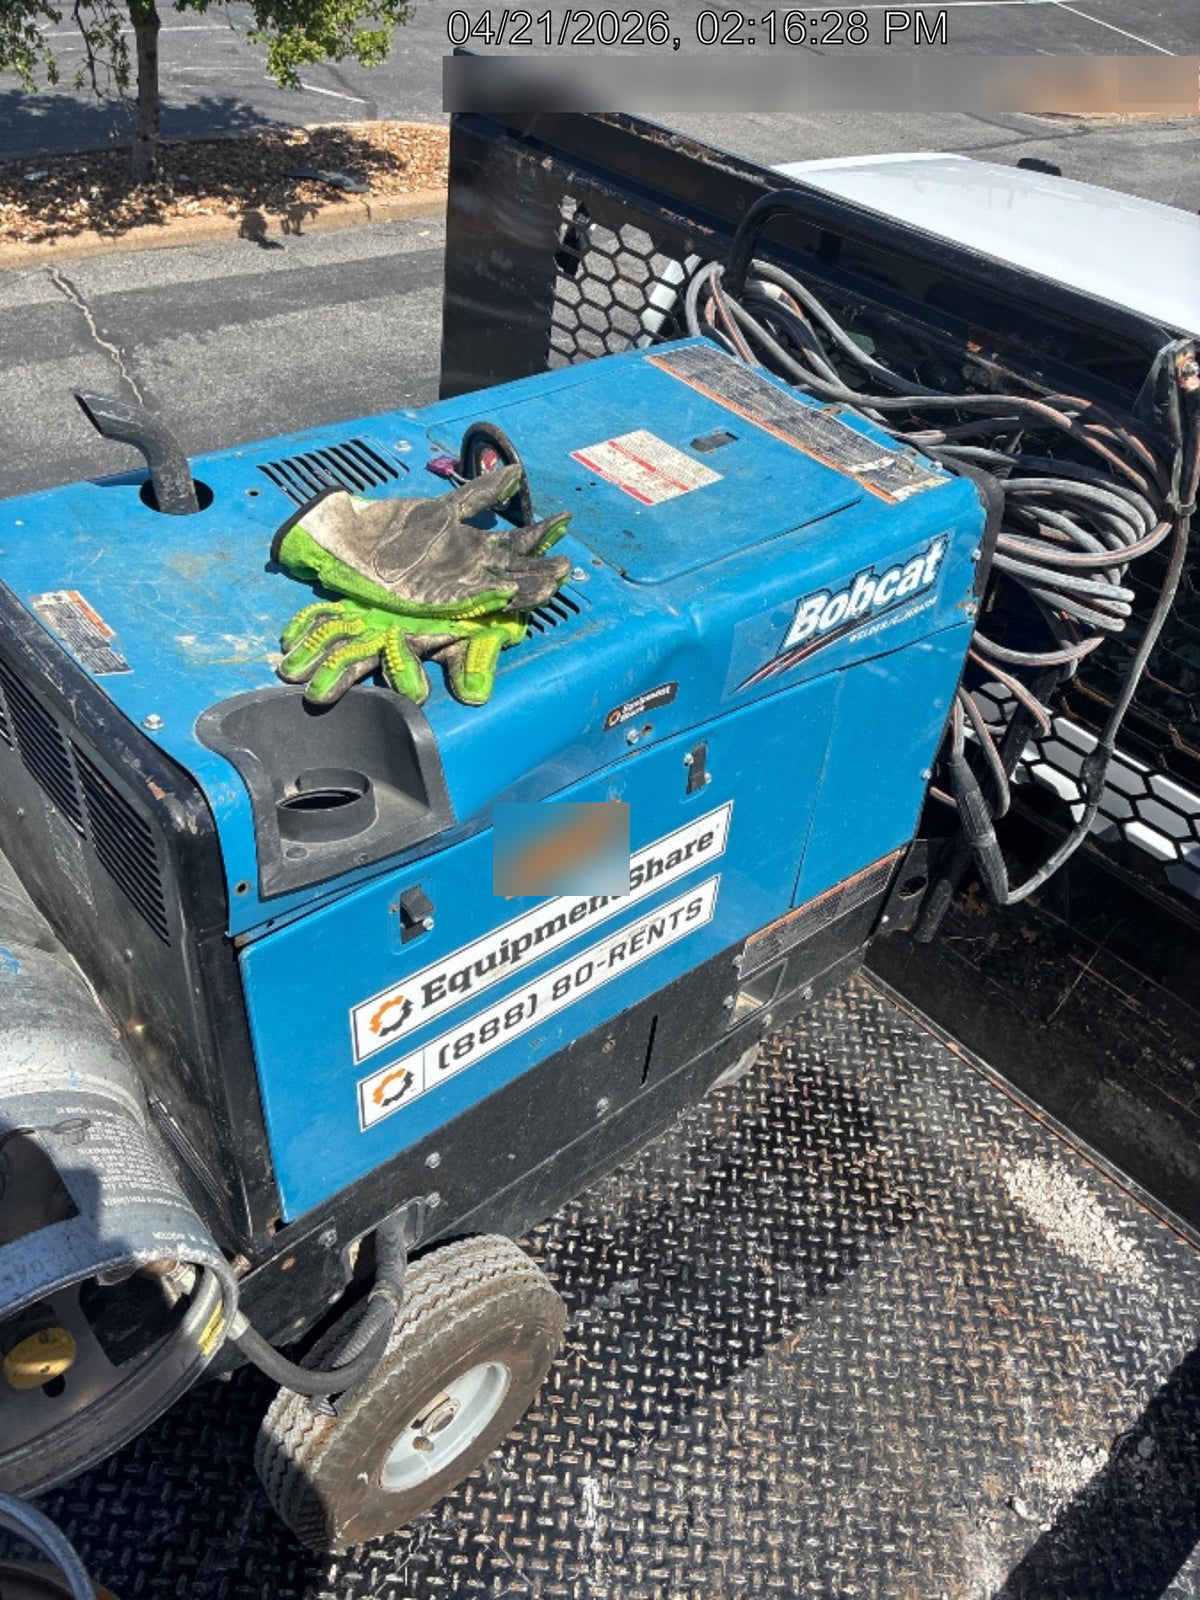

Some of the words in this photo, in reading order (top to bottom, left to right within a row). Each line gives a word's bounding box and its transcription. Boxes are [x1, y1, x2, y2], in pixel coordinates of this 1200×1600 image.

[779, 537, 948, 652] Bobcat
[421, 830, 714, 1009] EquipmenShare
[438, 993, 537, 1070] (888)
[552, 897, 704, 1002] 80-RENTS
